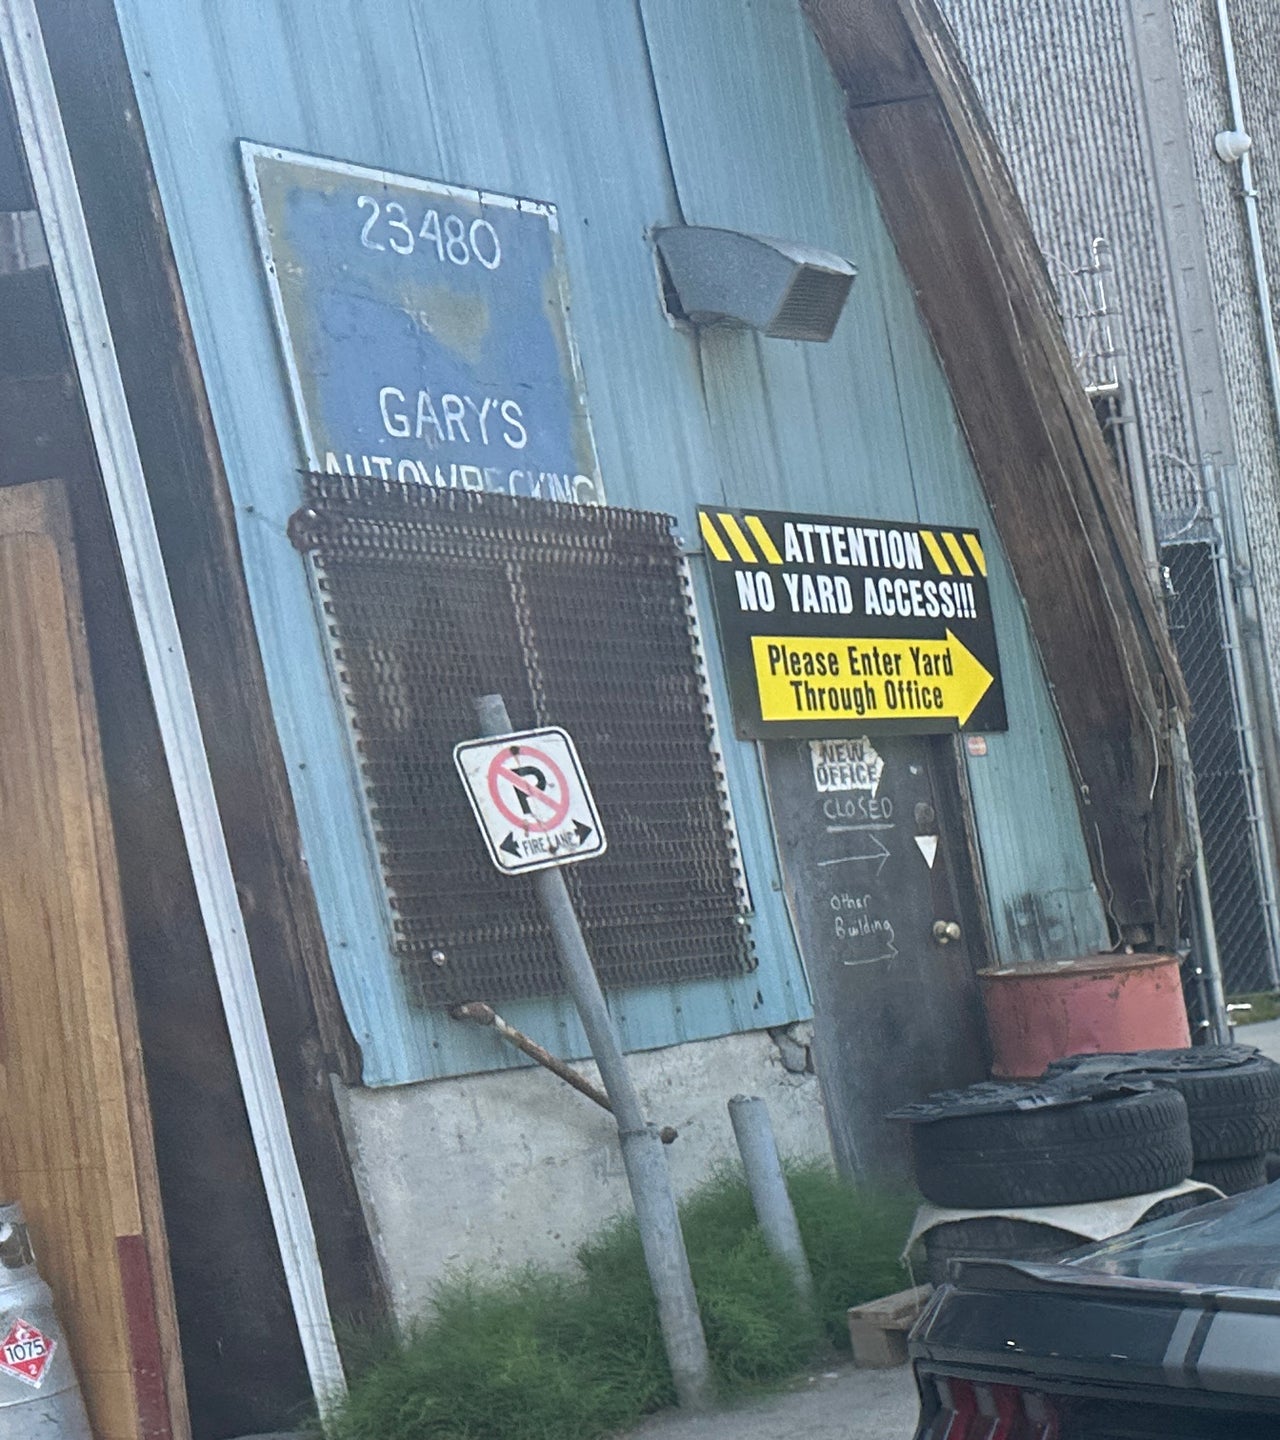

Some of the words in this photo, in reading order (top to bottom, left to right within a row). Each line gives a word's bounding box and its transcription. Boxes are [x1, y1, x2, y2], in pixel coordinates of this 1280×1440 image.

[357, 195, 501, 270] 23480
[379, 386, 527, 449] GARY'S
[783, 522, 924, 569] ATTENTION
[735, 570, 775, 612] NO
[782, 573, 853, 614] YARD
[865, 577, 977, 618] ACCESS!!!
[767, 645, 840, 676] Please
[847, 646, 901, 676] Enter
[910, 646, 954, 676] Yard
[789, 680, 877, 715] Through
[885, 679, 944, 710] Office
[818, 742, 865, 762] NEW
[817, 763, 878, 786] OFFICE
[823, 797, 894, 819] CLOSED
[521, 837, 549, 857] FIRE
[835, 916, 896, 944] Building
[6, 1339, 46, 1362] 1075
[28, 1363, 38, 1375] 2
